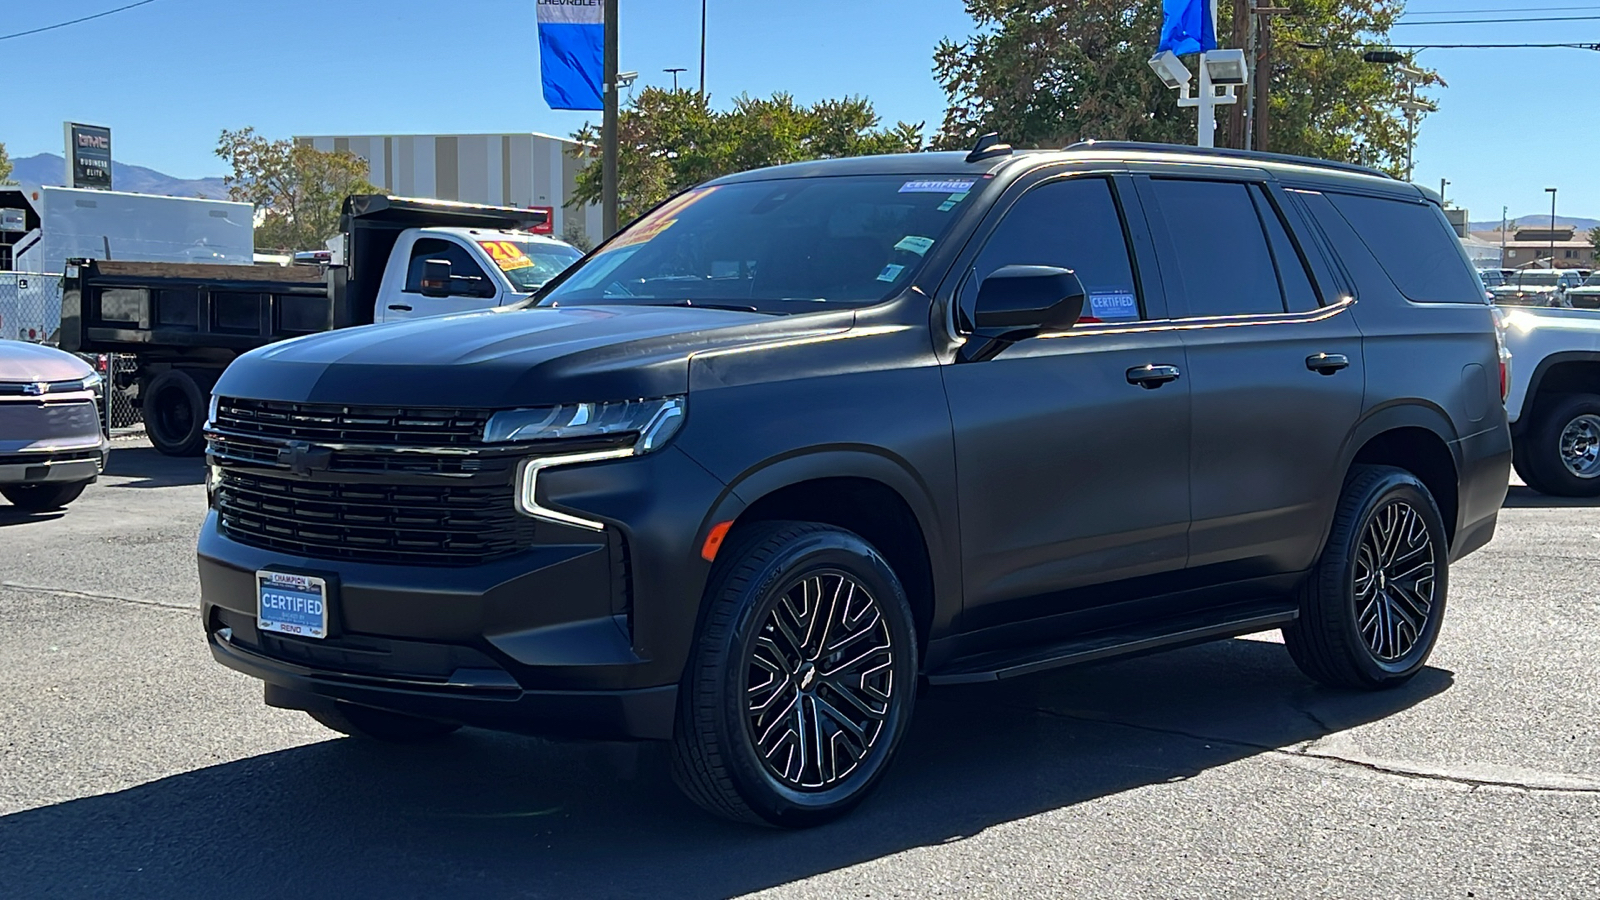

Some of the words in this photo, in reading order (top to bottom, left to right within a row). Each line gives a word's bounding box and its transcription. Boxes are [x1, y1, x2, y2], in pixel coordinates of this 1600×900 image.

[78, 134, 108, 149] GMC
[80, 157, 107, 168] BUSINESS
[86, 168, 103, 177] ELITE
[906, 181, 969, 189] CERTIFIED
[483, 241, 520, 260] 20
[1092, 296, 1133, 308] CERTIFIED
[274, 574, 306, 584] CHAMPION
[262, 593, 323, 615] CERTIFIED
[281, 624, 302, 634] RENO
